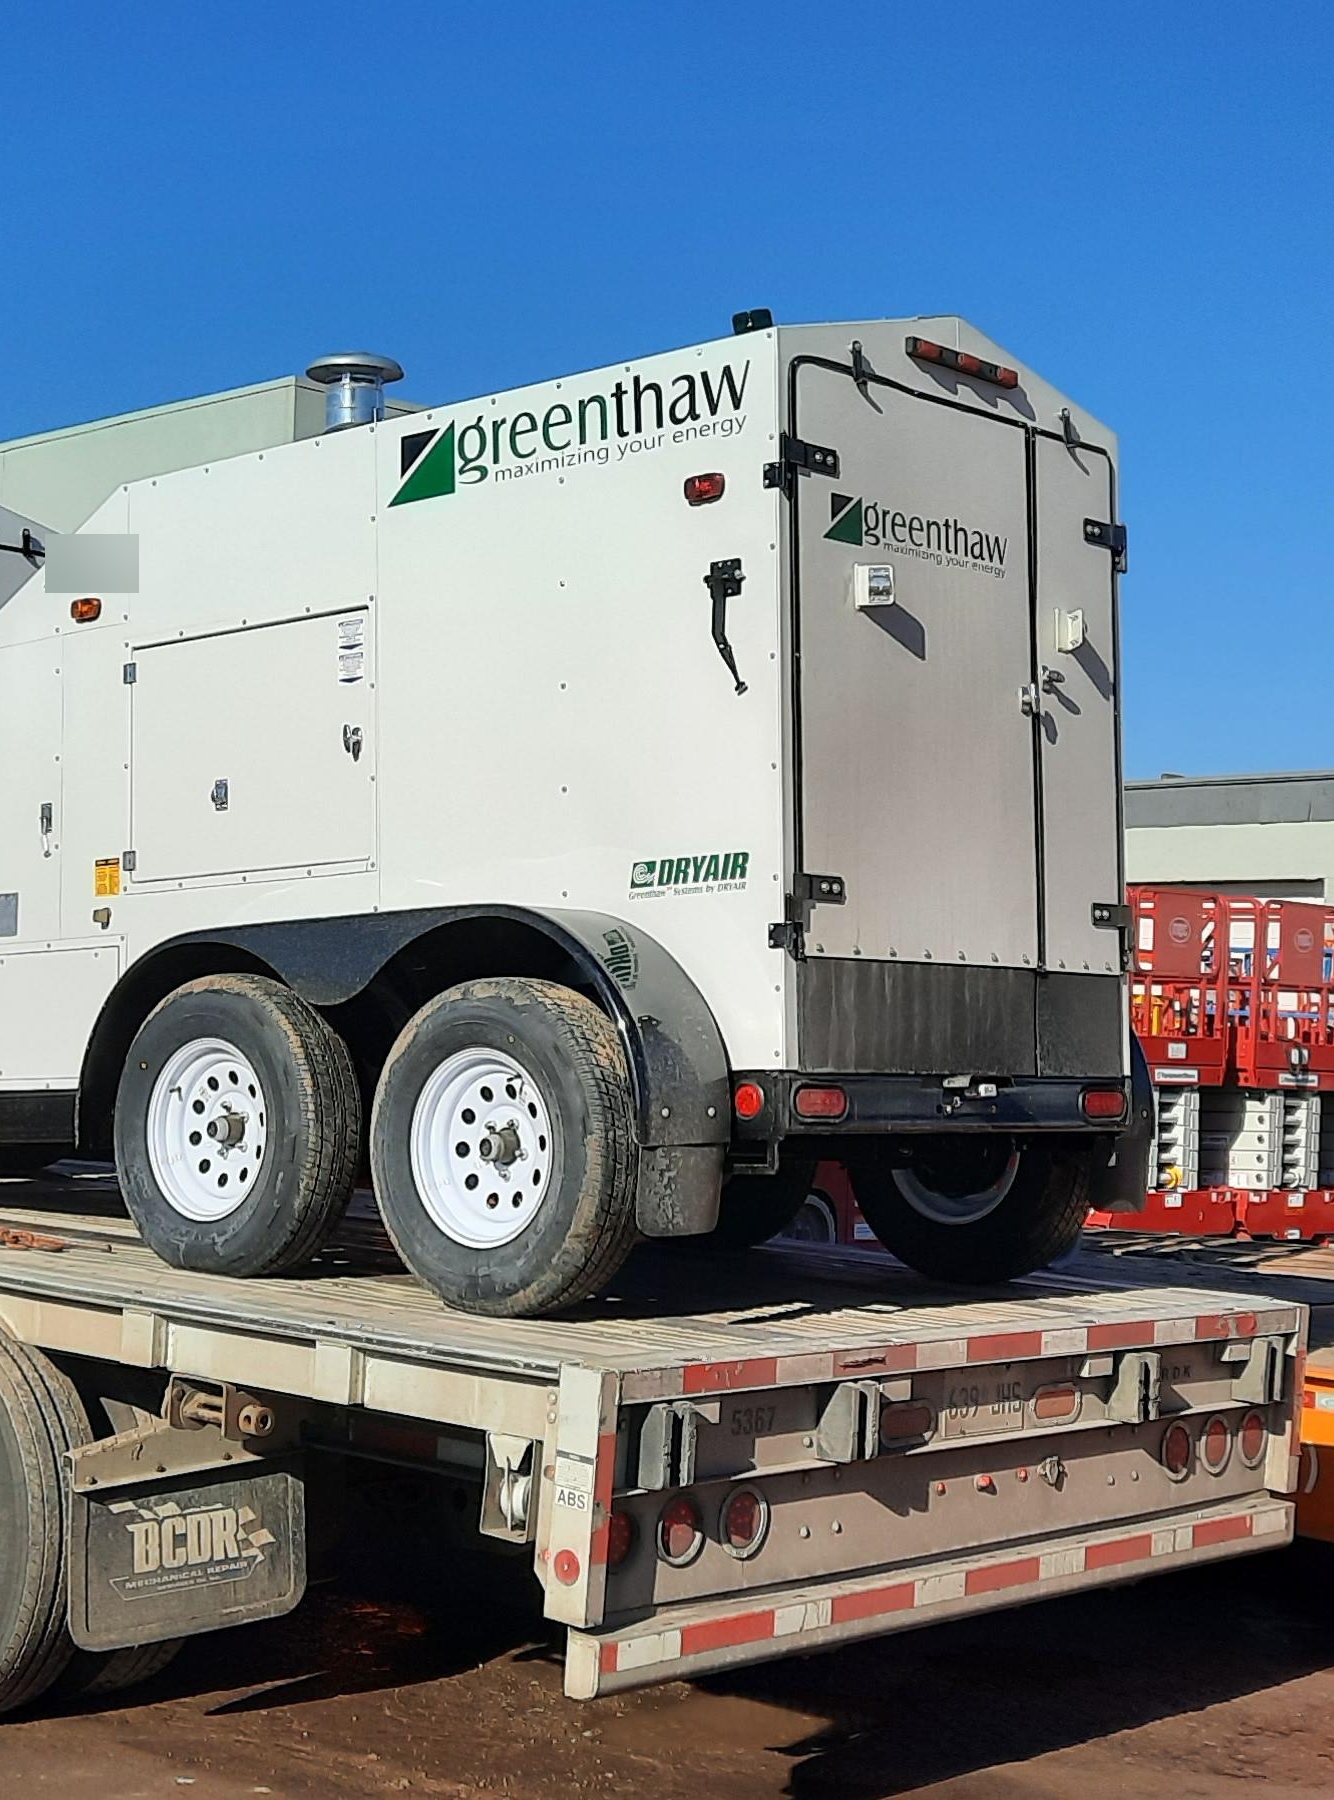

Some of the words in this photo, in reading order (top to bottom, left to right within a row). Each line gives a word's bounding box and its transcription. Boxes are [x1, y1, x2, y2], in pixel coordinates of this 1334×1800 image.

[457, 359, 750, 485] greenthaw
[493, 447, 609, 482] maximizing
[616, 433, 665, 461] your
[672, 415, 748, 444] energy
[863, 501, 1008, 566] greenthaw
[657, 851, 750, 886] DRYAIR
[731, 1406, 777, 1435] 5367
[557, 1488, 585, 1510] ABS
[125, 1507, 240, 1574] BCDR
[125, 1569, 203, 1590] MECHANICAL
[207, 1560, 248, 1574] REPAIR
